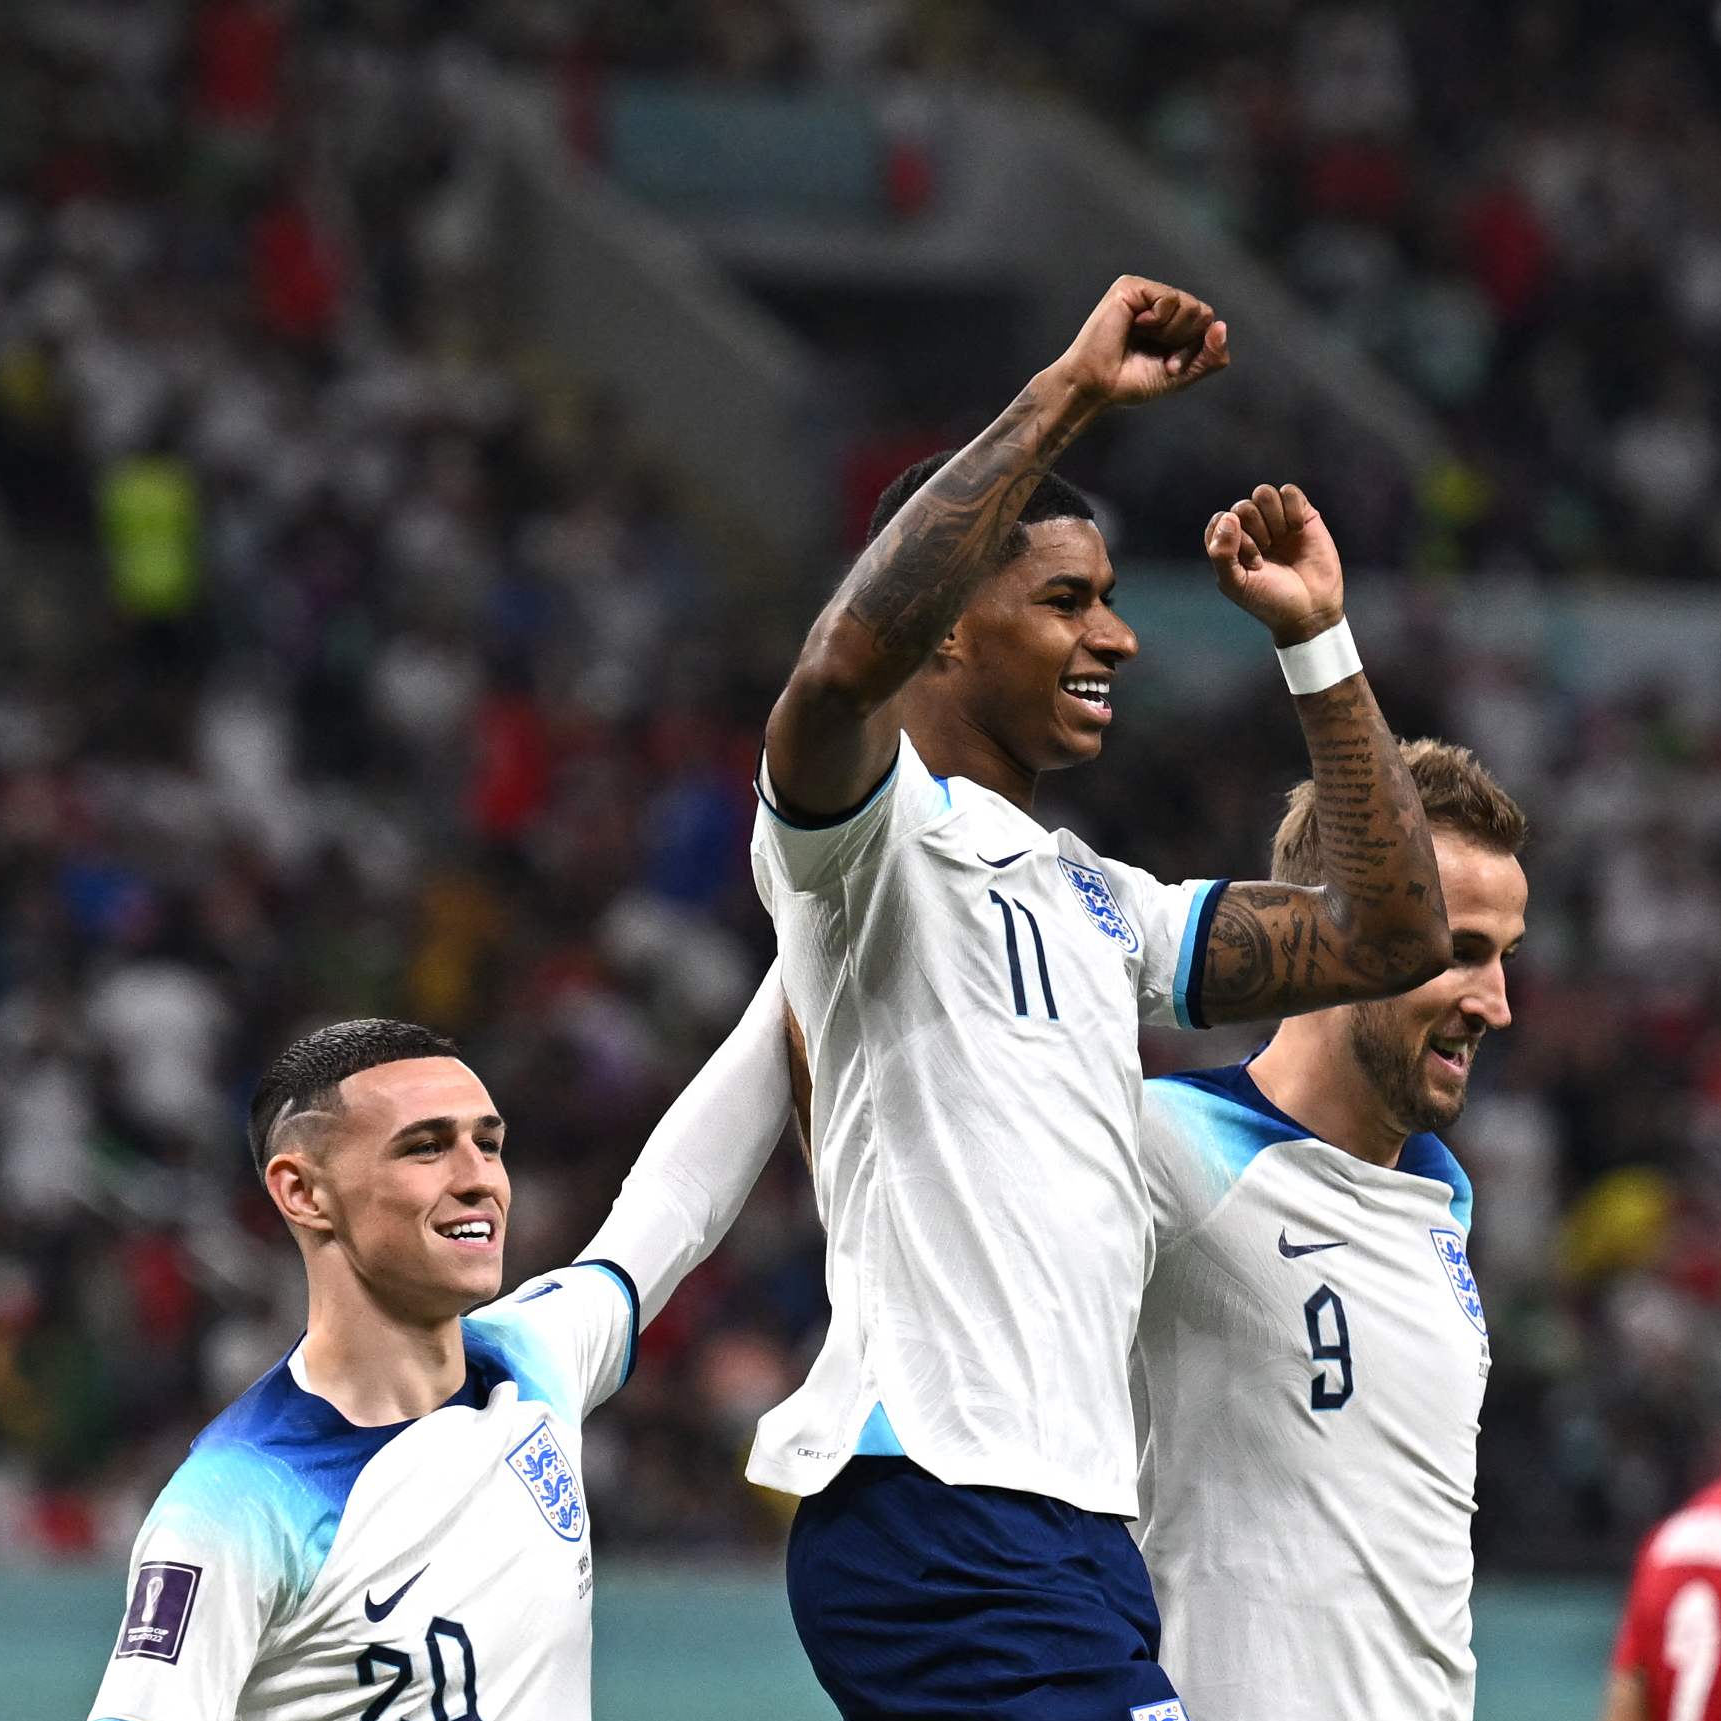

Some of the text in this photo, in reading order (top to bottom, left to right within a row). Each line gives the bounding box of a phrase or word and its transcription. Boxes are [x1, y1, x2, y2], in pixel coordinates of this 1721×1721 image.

[989, 889, 1060, 1022] 11
[1303, 1283, 1354, 1413] 9
[797, 1447, 839, 1460] DRI-F
